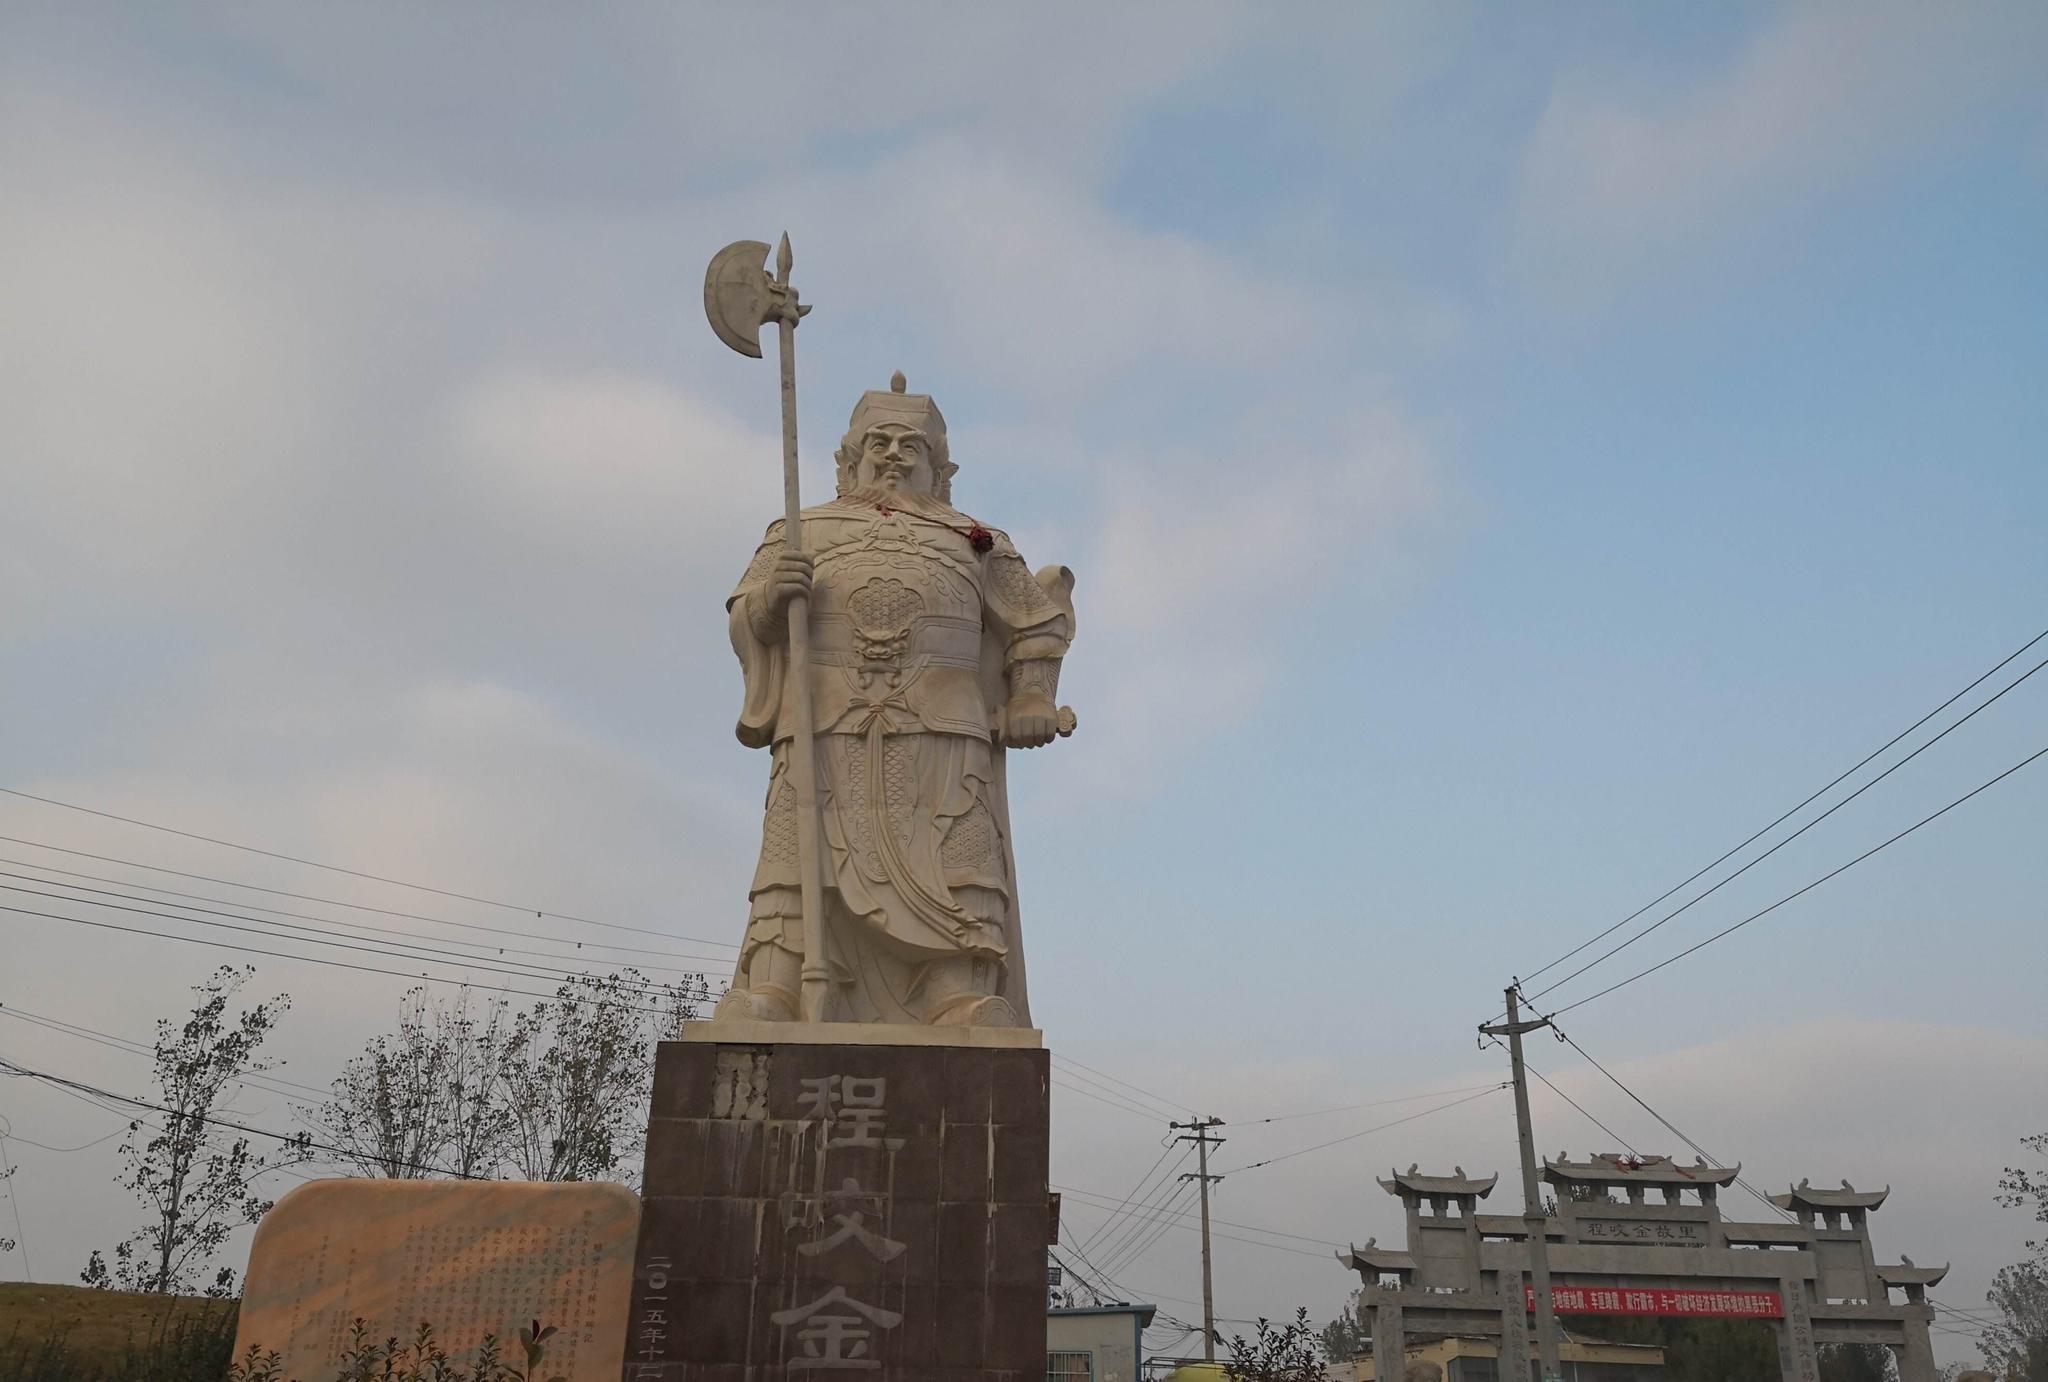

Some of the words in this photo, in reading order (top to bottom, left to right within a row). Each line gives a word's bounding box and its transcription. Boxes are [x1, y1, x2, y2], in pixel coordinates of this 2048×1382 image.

[771, 1074, 909, 1371] 程咬金
[1588, 1223, 1697, 1239] 程咬金故里
